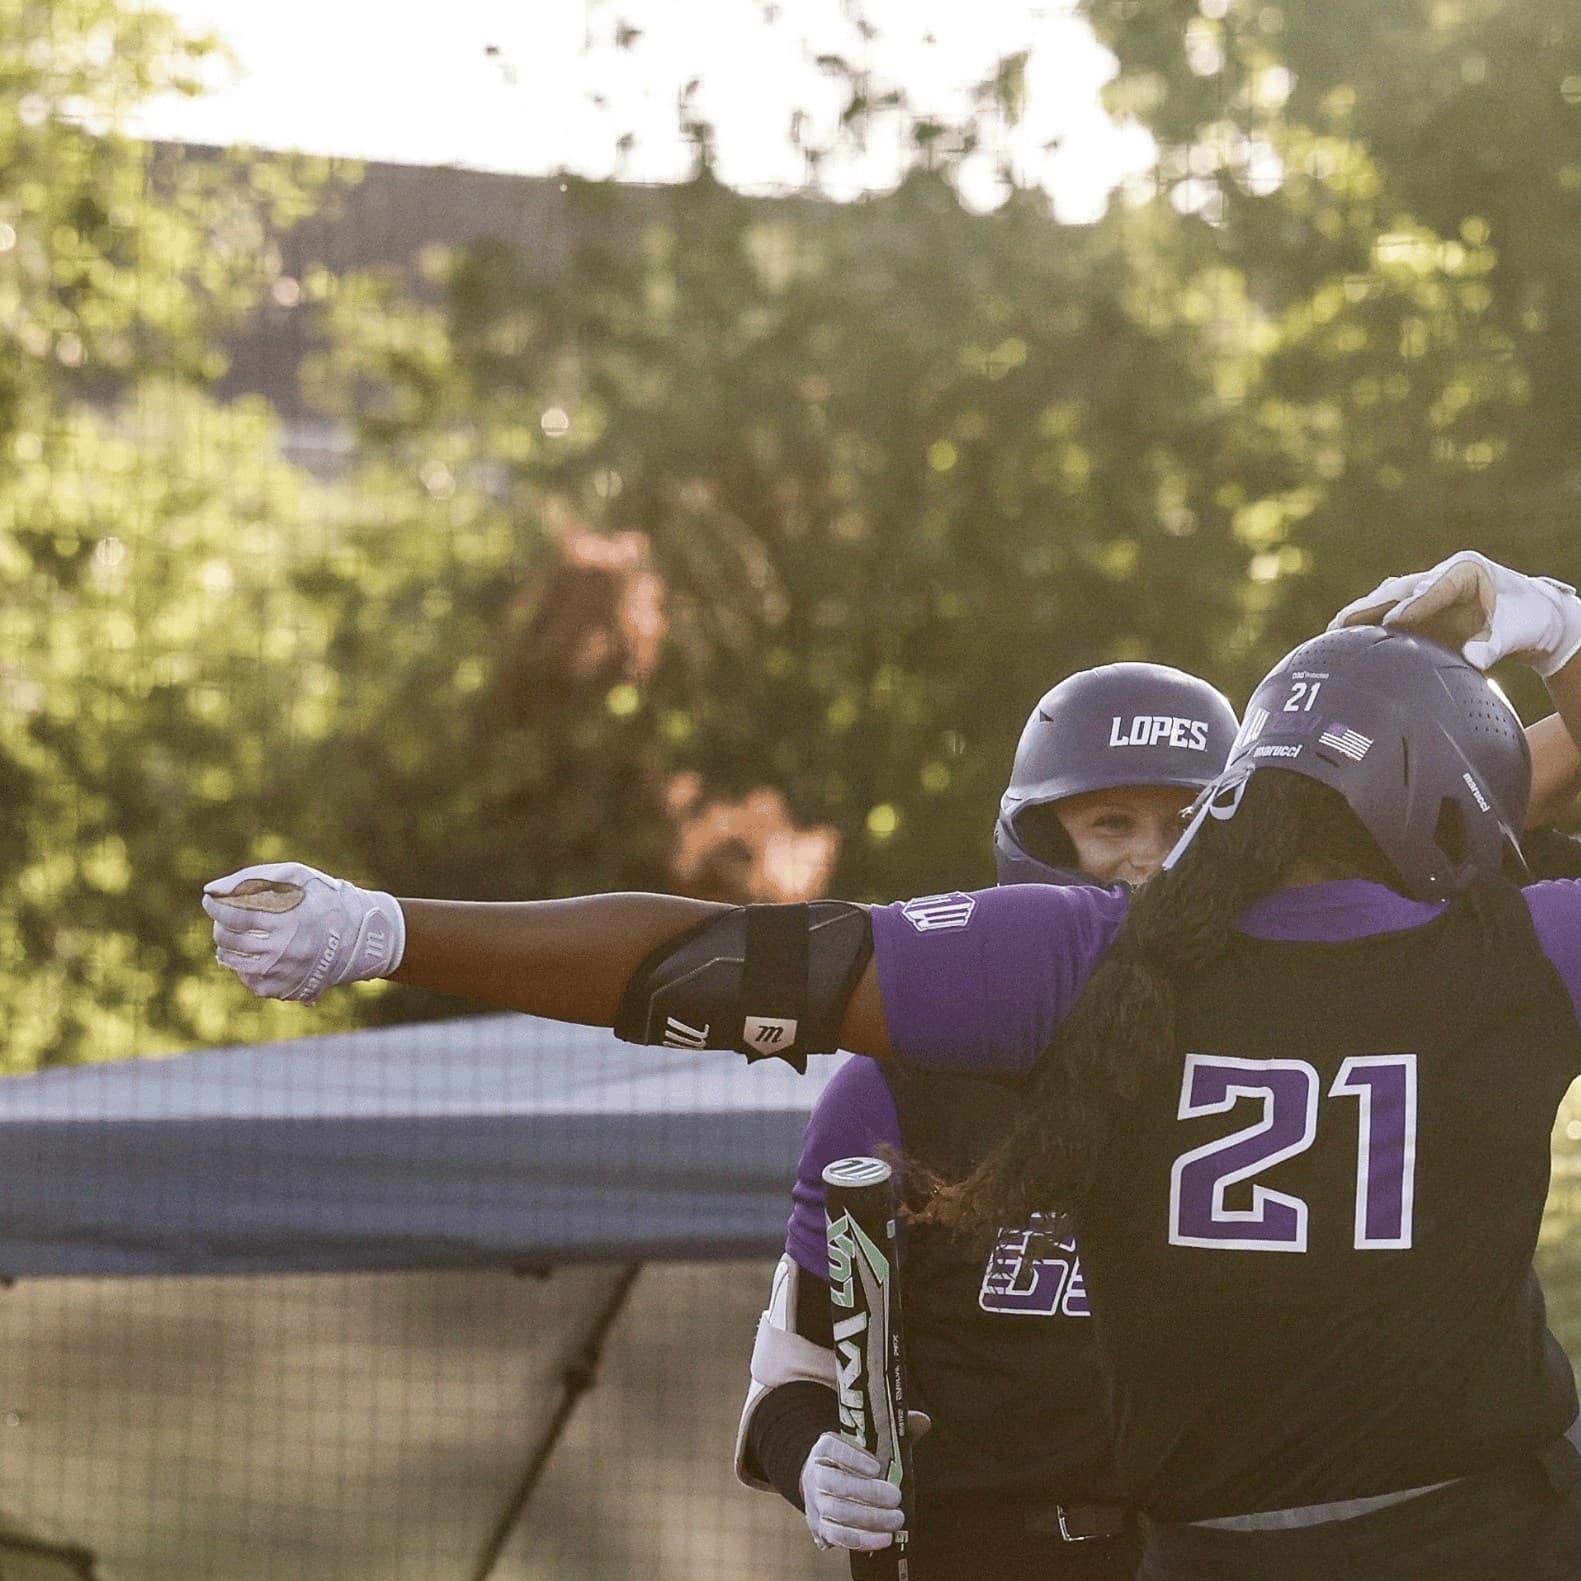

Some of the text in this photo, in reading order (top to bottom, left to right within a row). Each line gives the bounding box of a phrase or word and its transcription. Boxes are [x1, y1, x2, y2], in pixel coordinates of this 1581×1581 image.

[1284, 682, 1321, 711] 21
[1109, 715, 1208, 751] LOPES
[1168, 1053, 1417, 1253] 21
[826, 1214, 856, 1308] LUX
